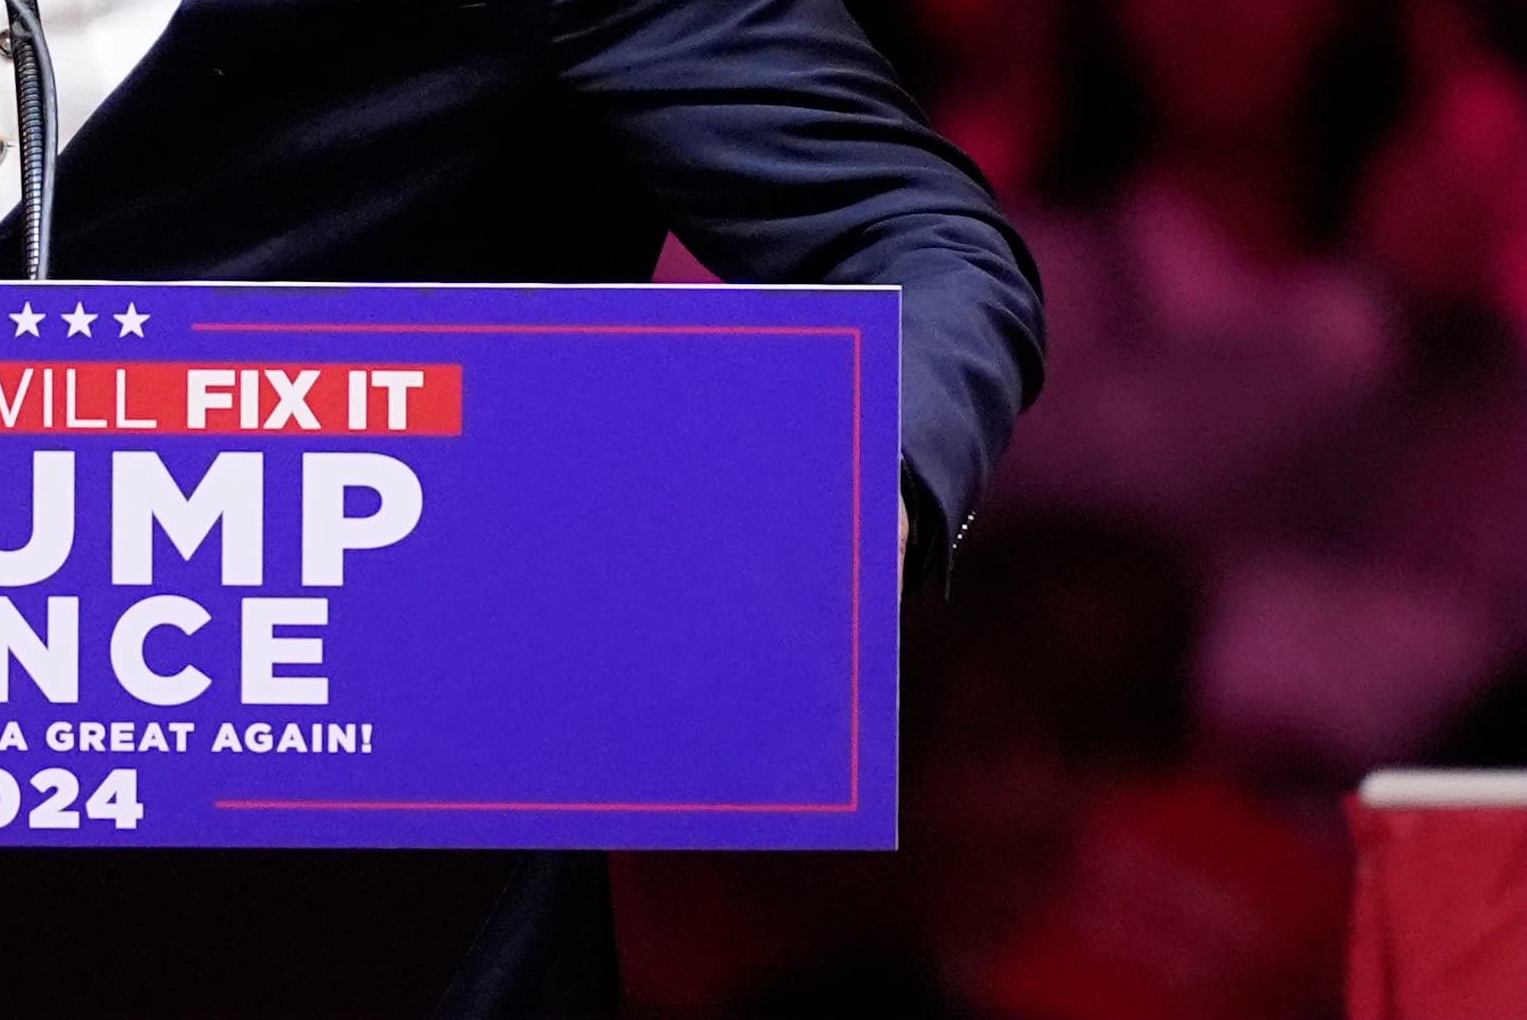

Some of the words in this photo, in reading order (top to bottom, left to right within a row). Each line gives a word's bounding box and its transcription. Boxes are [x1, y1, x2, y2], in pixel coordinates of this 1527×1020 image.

[186, 368, 323, 431] FIX
[347, 369, 425, 431] IT
[45, 720, 196, 753] GREAT
[210, 721, 374, 754] AGAIN!
